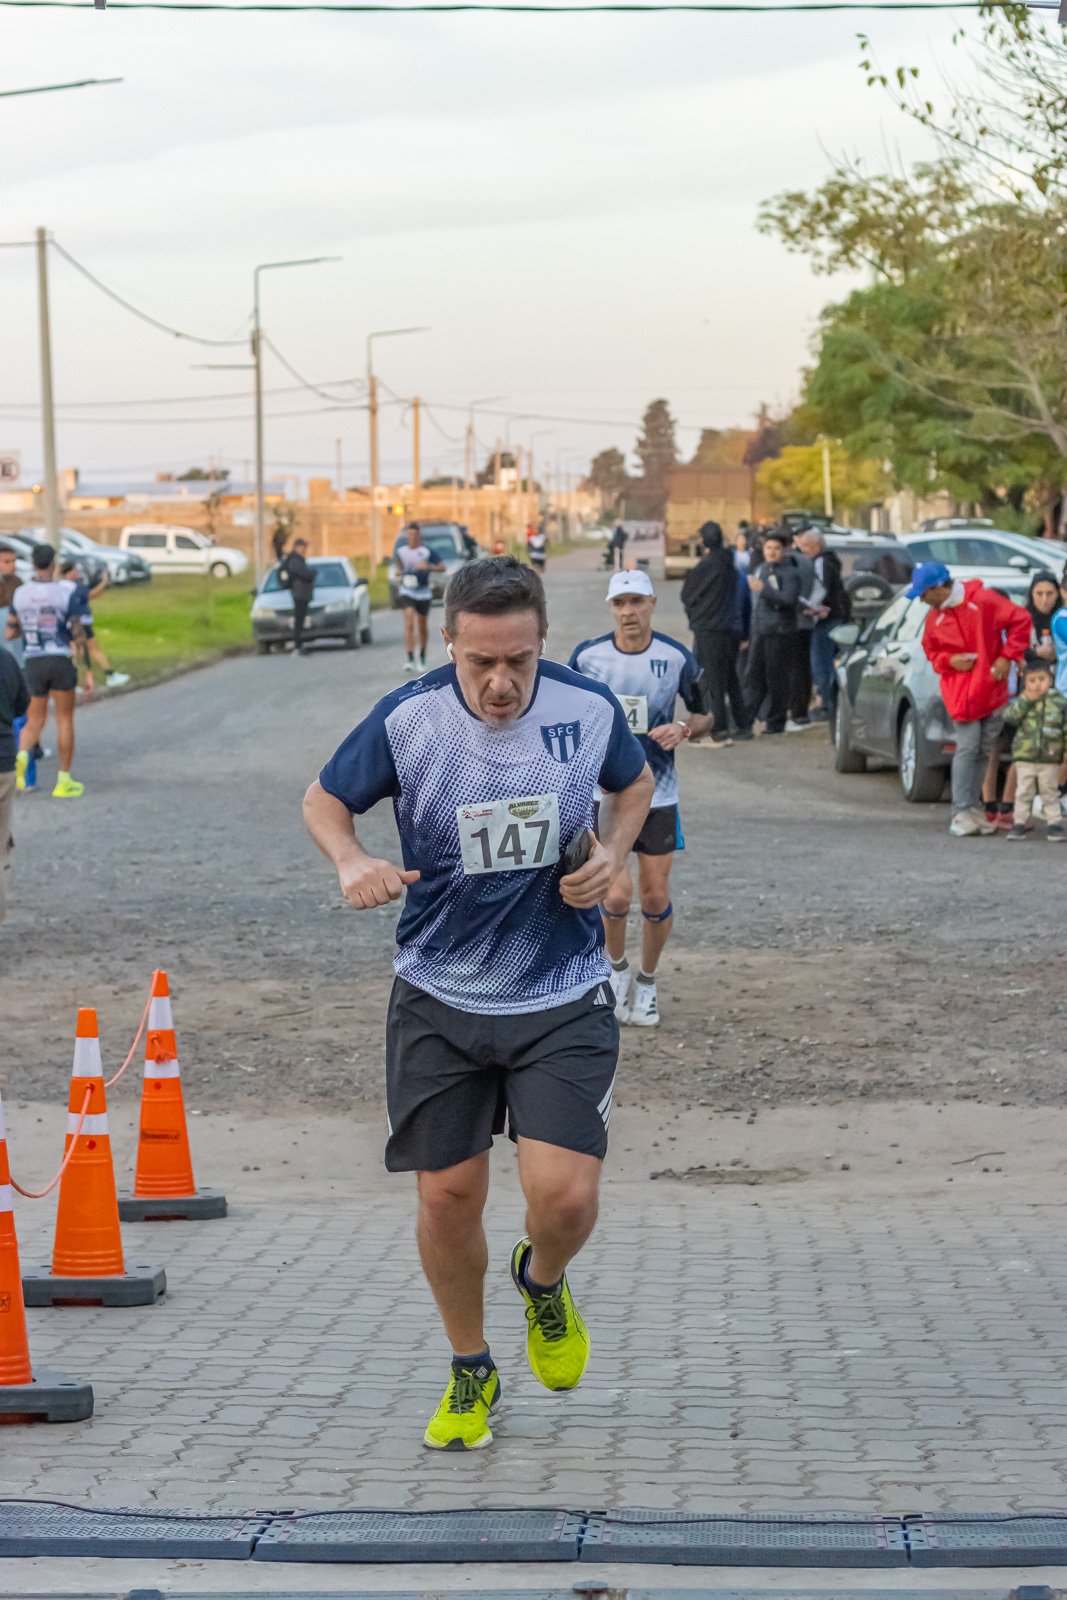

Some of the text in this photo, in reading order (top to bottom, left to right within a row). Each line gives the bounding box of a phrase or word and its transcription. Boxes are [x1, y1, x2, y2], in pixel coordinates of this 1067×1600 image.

[627, 709, 638, 727] 4
[548, 725, 574, 737] SFC
[508, 801, 539, 809] ALVAREZ
[510, 805, 539, 813] CORRE
[470, 820, 550, 869] 147
